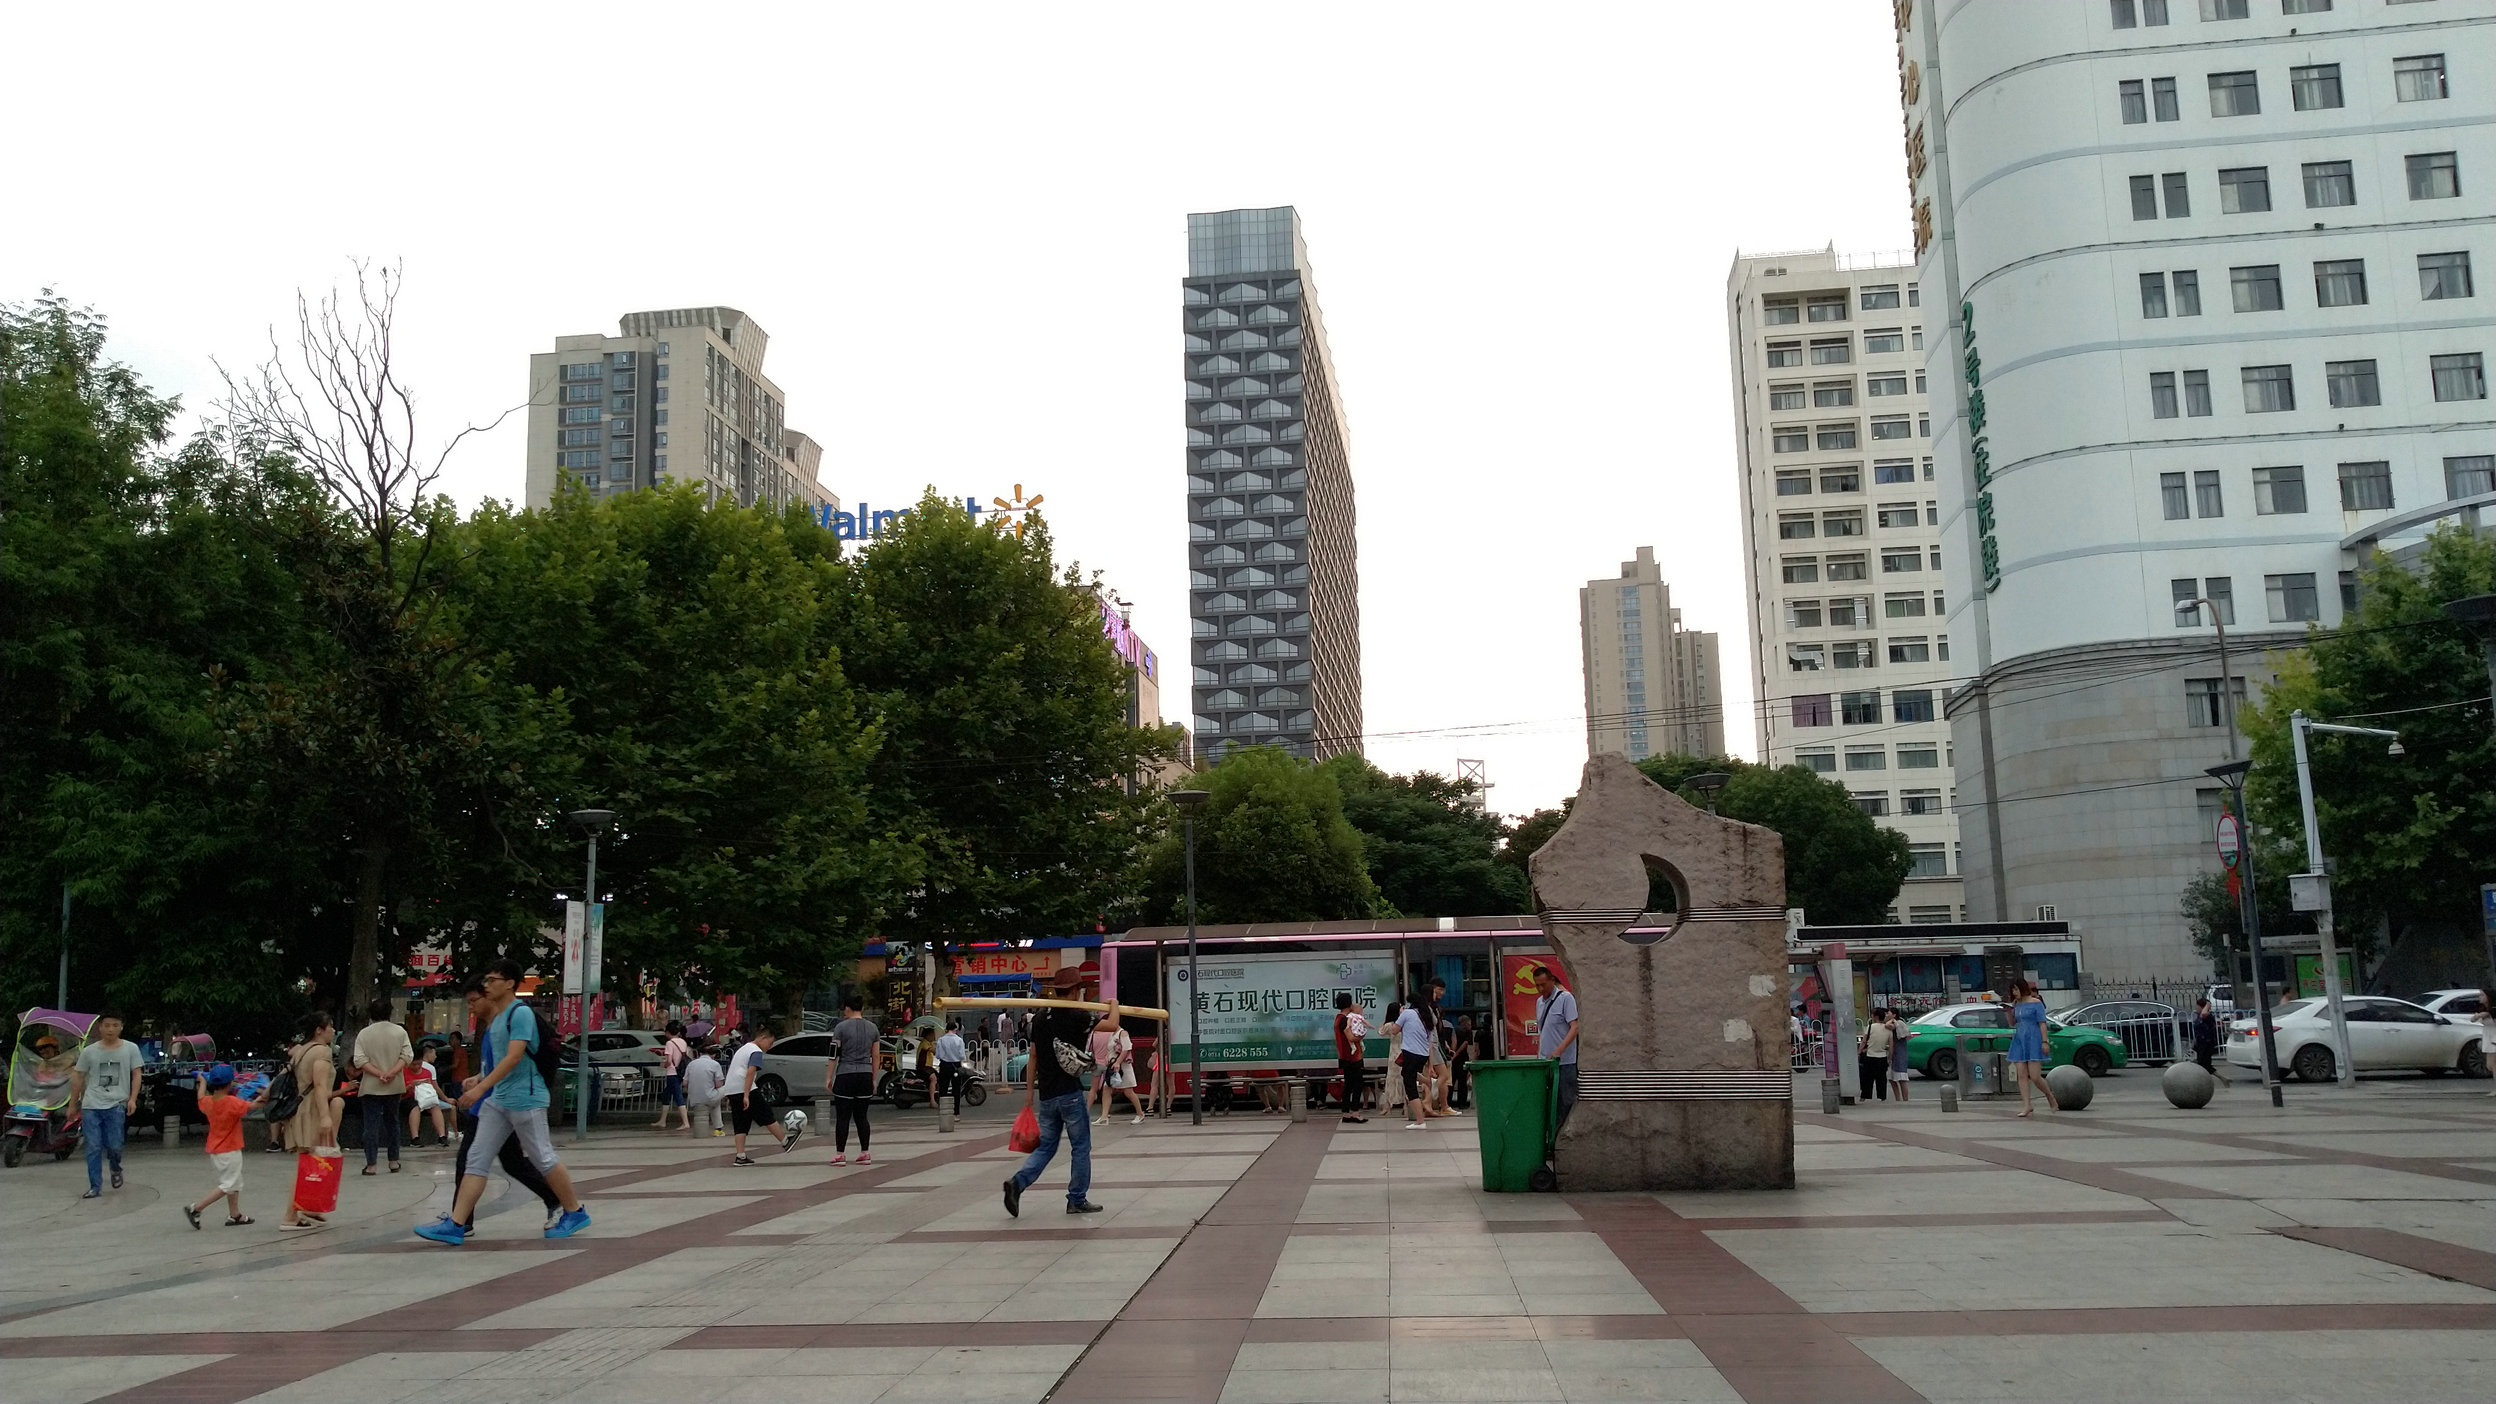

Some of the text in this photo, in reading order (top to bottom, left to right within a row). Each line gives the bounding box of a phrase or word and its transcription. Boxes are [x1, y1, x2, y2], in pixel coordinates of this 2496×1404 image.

[810, 497, 982, 540] almt
[952, 955, 1028, 975] 营销中心
[888, 980, 912, 1013] 北街
[1889, 996, 1977, 1006] 参加无偿血
[1223, 1048, 1247, 1058] 6228
[1250, 1047, 1268, 1057] 555
